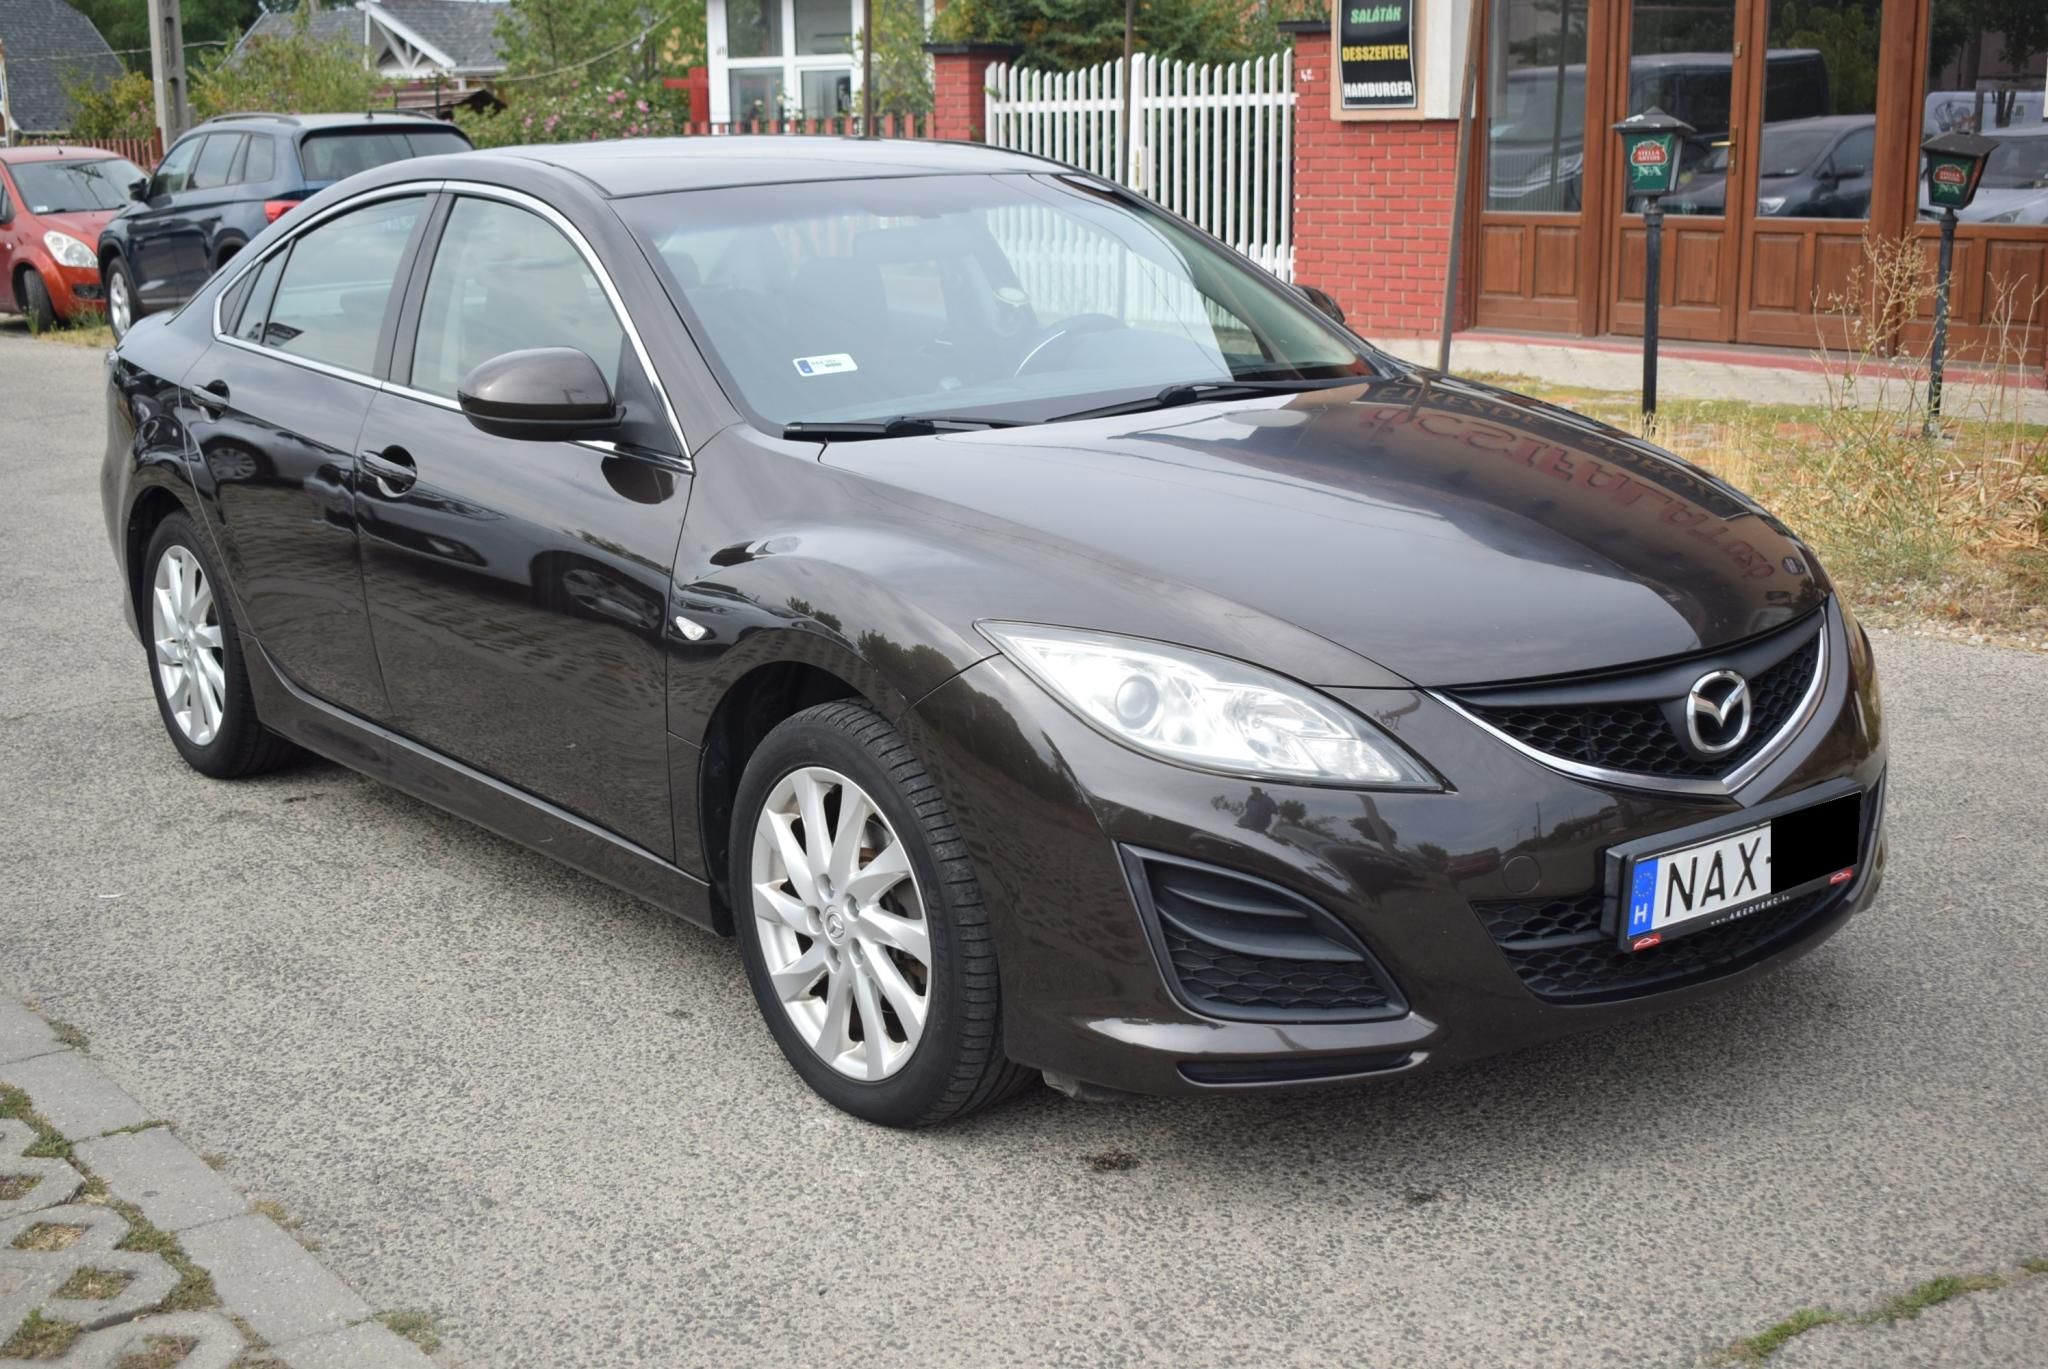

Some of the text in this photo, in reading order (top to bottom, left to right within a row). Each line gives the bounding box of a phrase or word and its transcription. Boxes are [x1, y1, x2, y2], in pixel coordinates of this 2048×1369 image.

[1350, 5, 1402, 24] SALÁTÁK
[1342, 44, 1409, 62] DESSZERTEK
[1343, 81, 1413, 98] HAMBURGER
[1633, 902, 1648, 925] H
